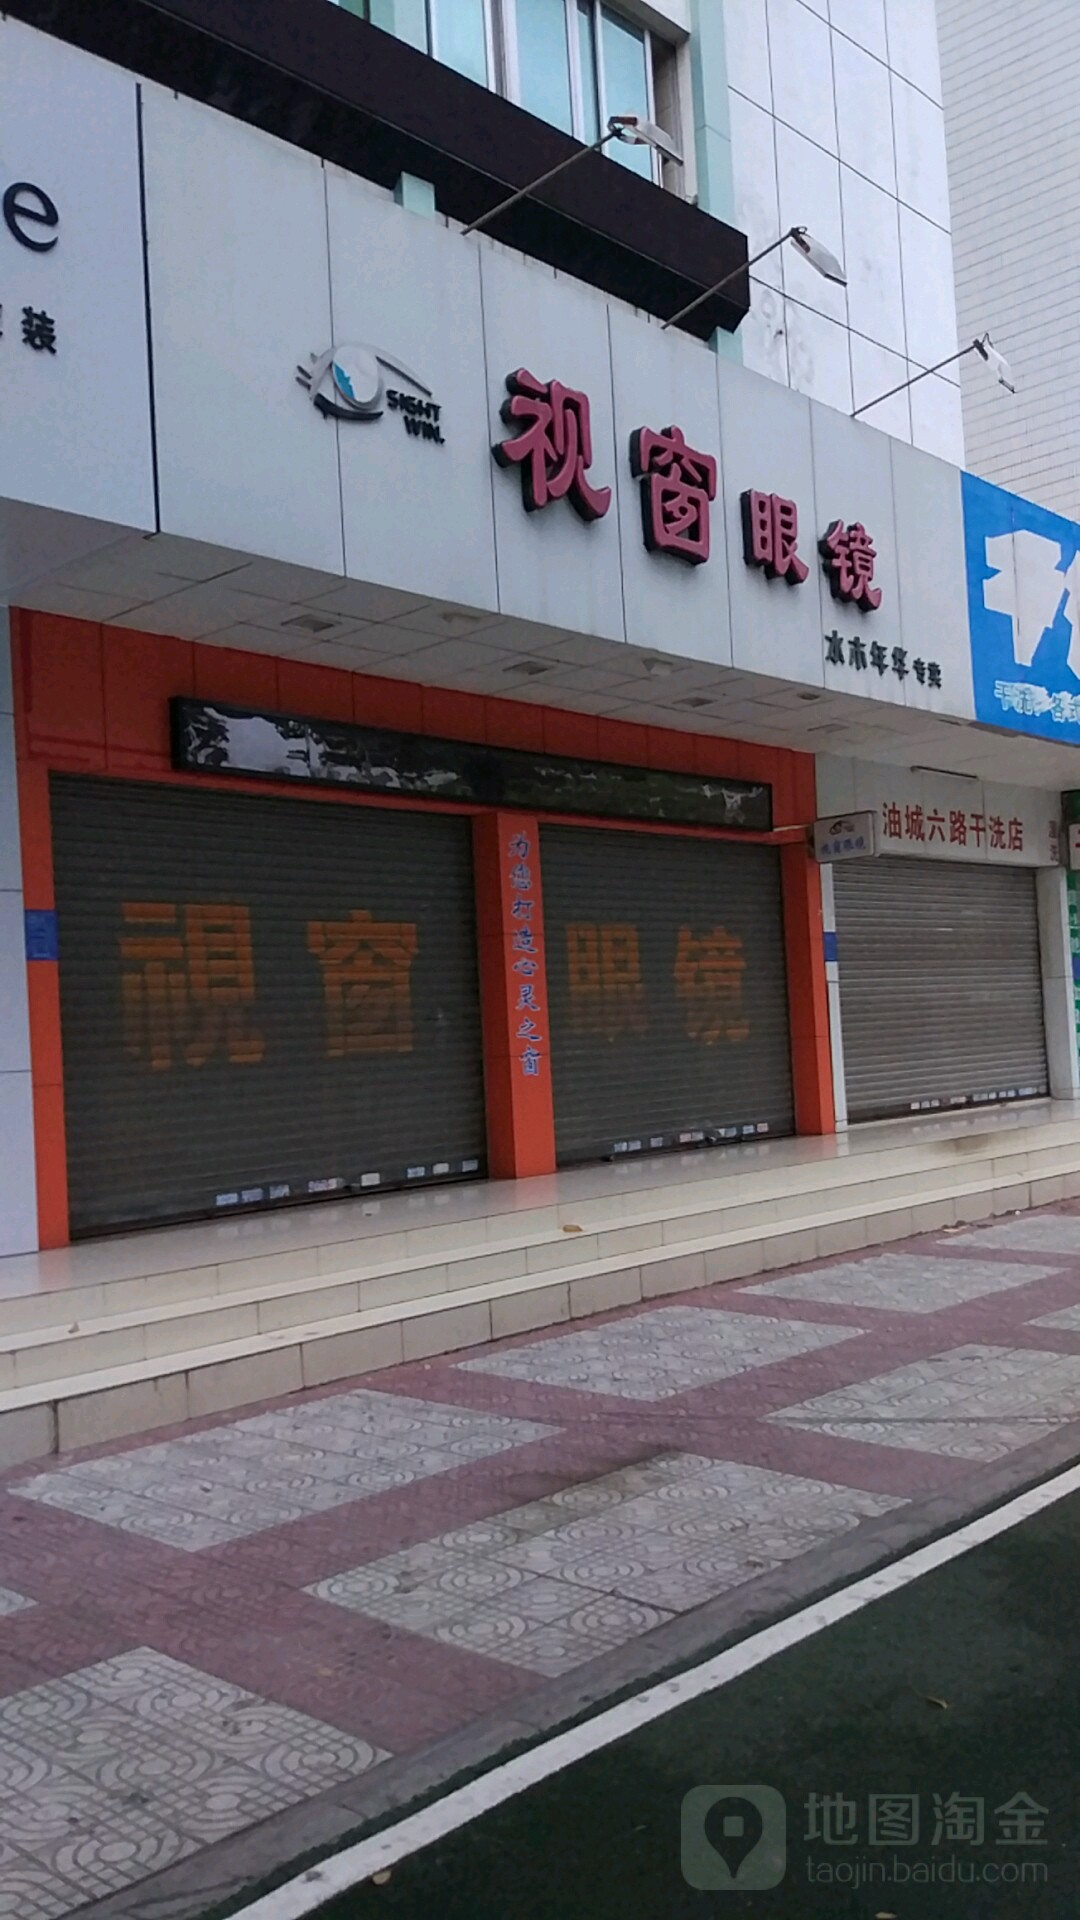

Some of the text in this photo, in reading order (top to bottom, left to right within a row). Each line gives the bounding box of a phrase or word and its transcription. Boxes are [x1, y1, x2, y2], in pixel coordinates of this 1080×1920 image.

[0, 305, 57, 355] 装
[386, 388, 442, 422] SIGHT
[491, 367, 883, 612] 视窗眼镜
[882, 801, 1024, 852] 油城六路干洗店
[507, 831, 542, 1076] 为您打造心灵之窗
